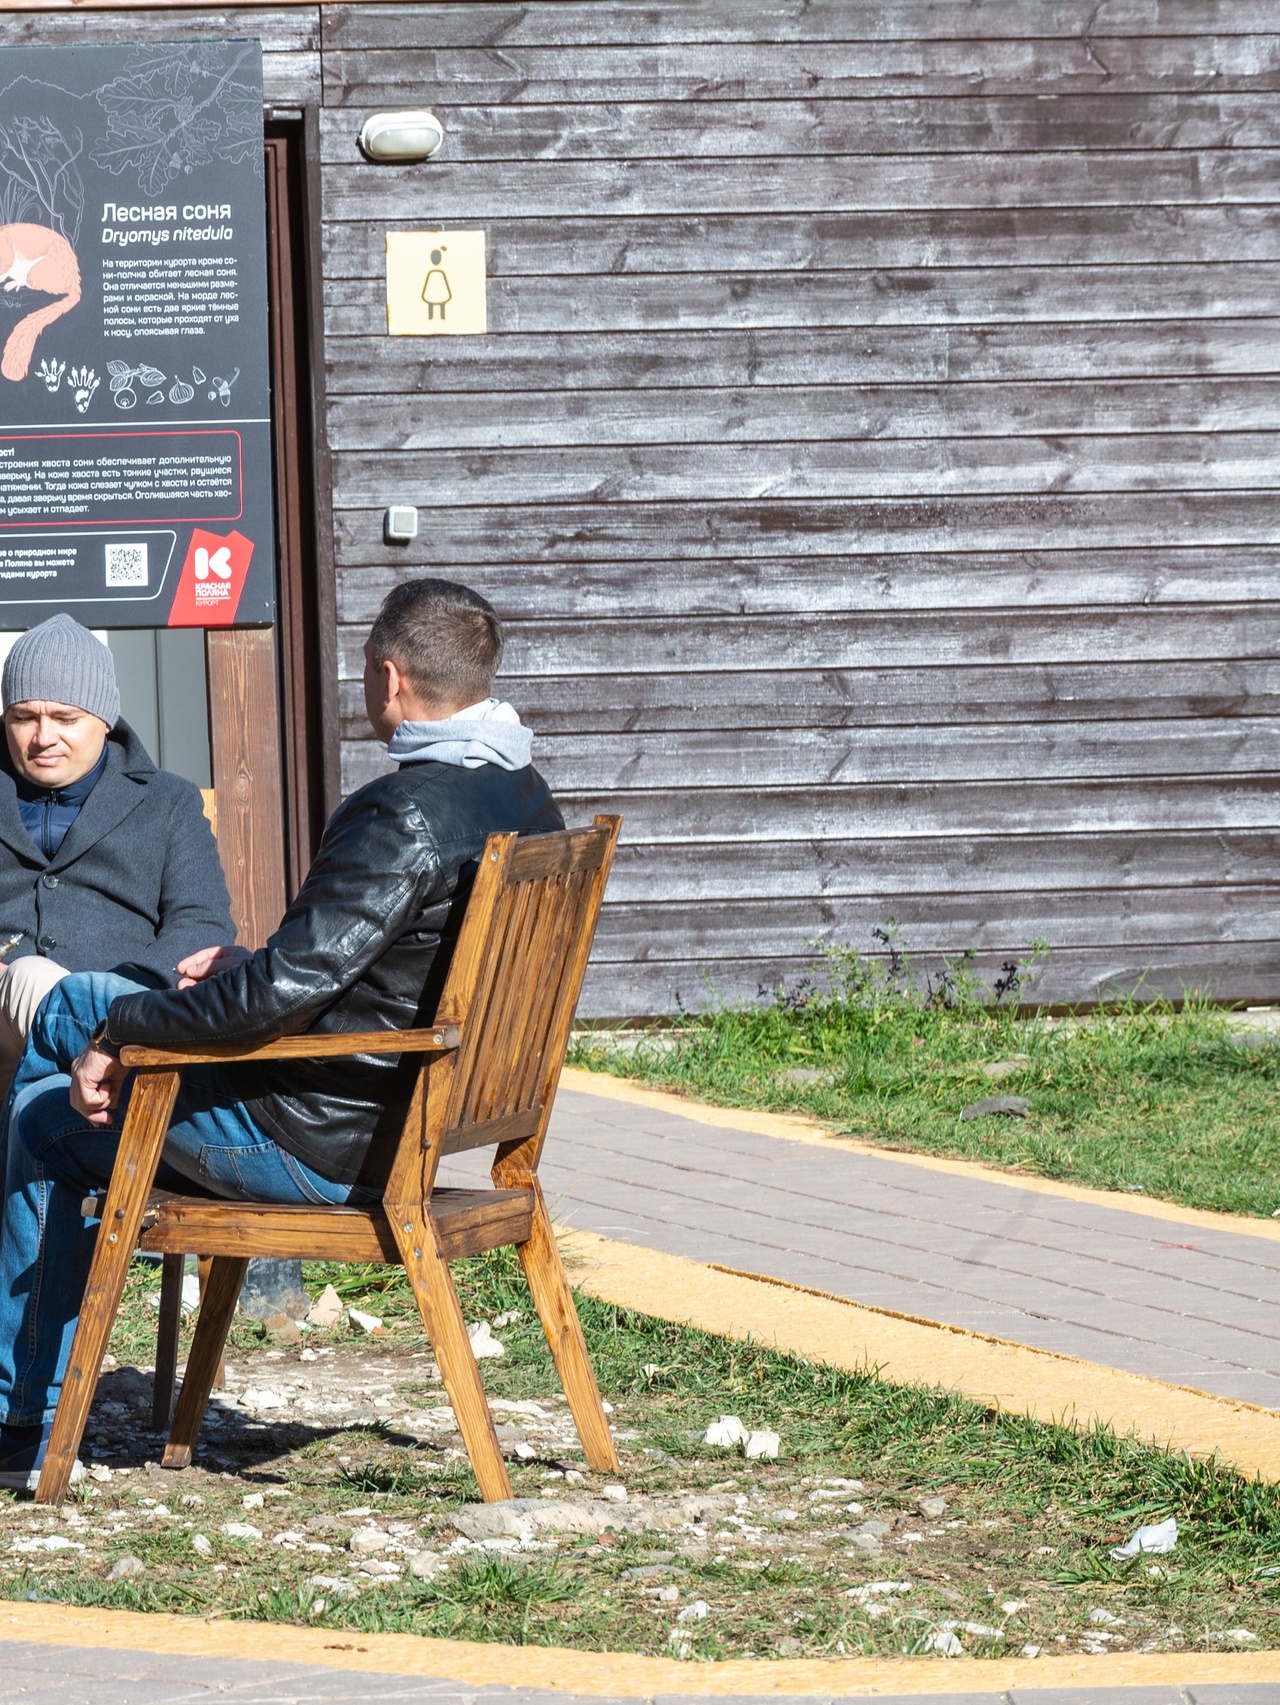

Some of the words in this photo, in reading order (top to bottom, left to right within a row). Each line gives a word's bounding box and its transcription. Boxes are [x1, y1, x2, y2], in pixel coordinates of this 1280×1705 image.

[101, 202, 177, 222] Лесная
[183, 204, 231, 220] соня
[102, 227, 170, 247] Dryomys
[173, 224, 233, 241] nitedula
[102, 259, 114, 268] На
[115, 259, 163, 269] территории
[163, 258, 197, 268] курорта
[198, 257, 223, 267] кроме
[102, 271, 147, 280] ни-полчка
[148, 268, 182, 278] обитает
[184, 269, 214, 277] лесная
[103, 281, 119, 291] Она
[120, 282, 166, 291] отличается
[166, 281, 209, 289] меньшими
[103, 295, 125, 304] рами
[178, 291, 190, 301] На
[192, 292, 218, 302] морде
[103, 305, 119, 314] ной
[121, 306, 141, 314] сони
[143, 305, 162, 313] есть
[164, 305, 180, 313] две
[181, 304, 206, 313] яркие
[208, 302, 239, 311] тёмные
[138, 316, 173, 326] которые
[174, 315, 212, 325] проходят
[214, 315, 223, 323] от
[225, 314, 239, 325] уха
[134, 327, 179, 336] опоясывая
[7, 506, 42, 517] усыхает
[14, 549, 57, 558] природном
[57, 548, 77, 557] мире
[4, 559, 33, 568] Поляна
[46, 559, 75, 567] можете
[26, 570, 57, 580] курорта
[194, 582, 232, 590] КРАСНАЯ
[195, 588, 229, 597] ПОЛЯНА
